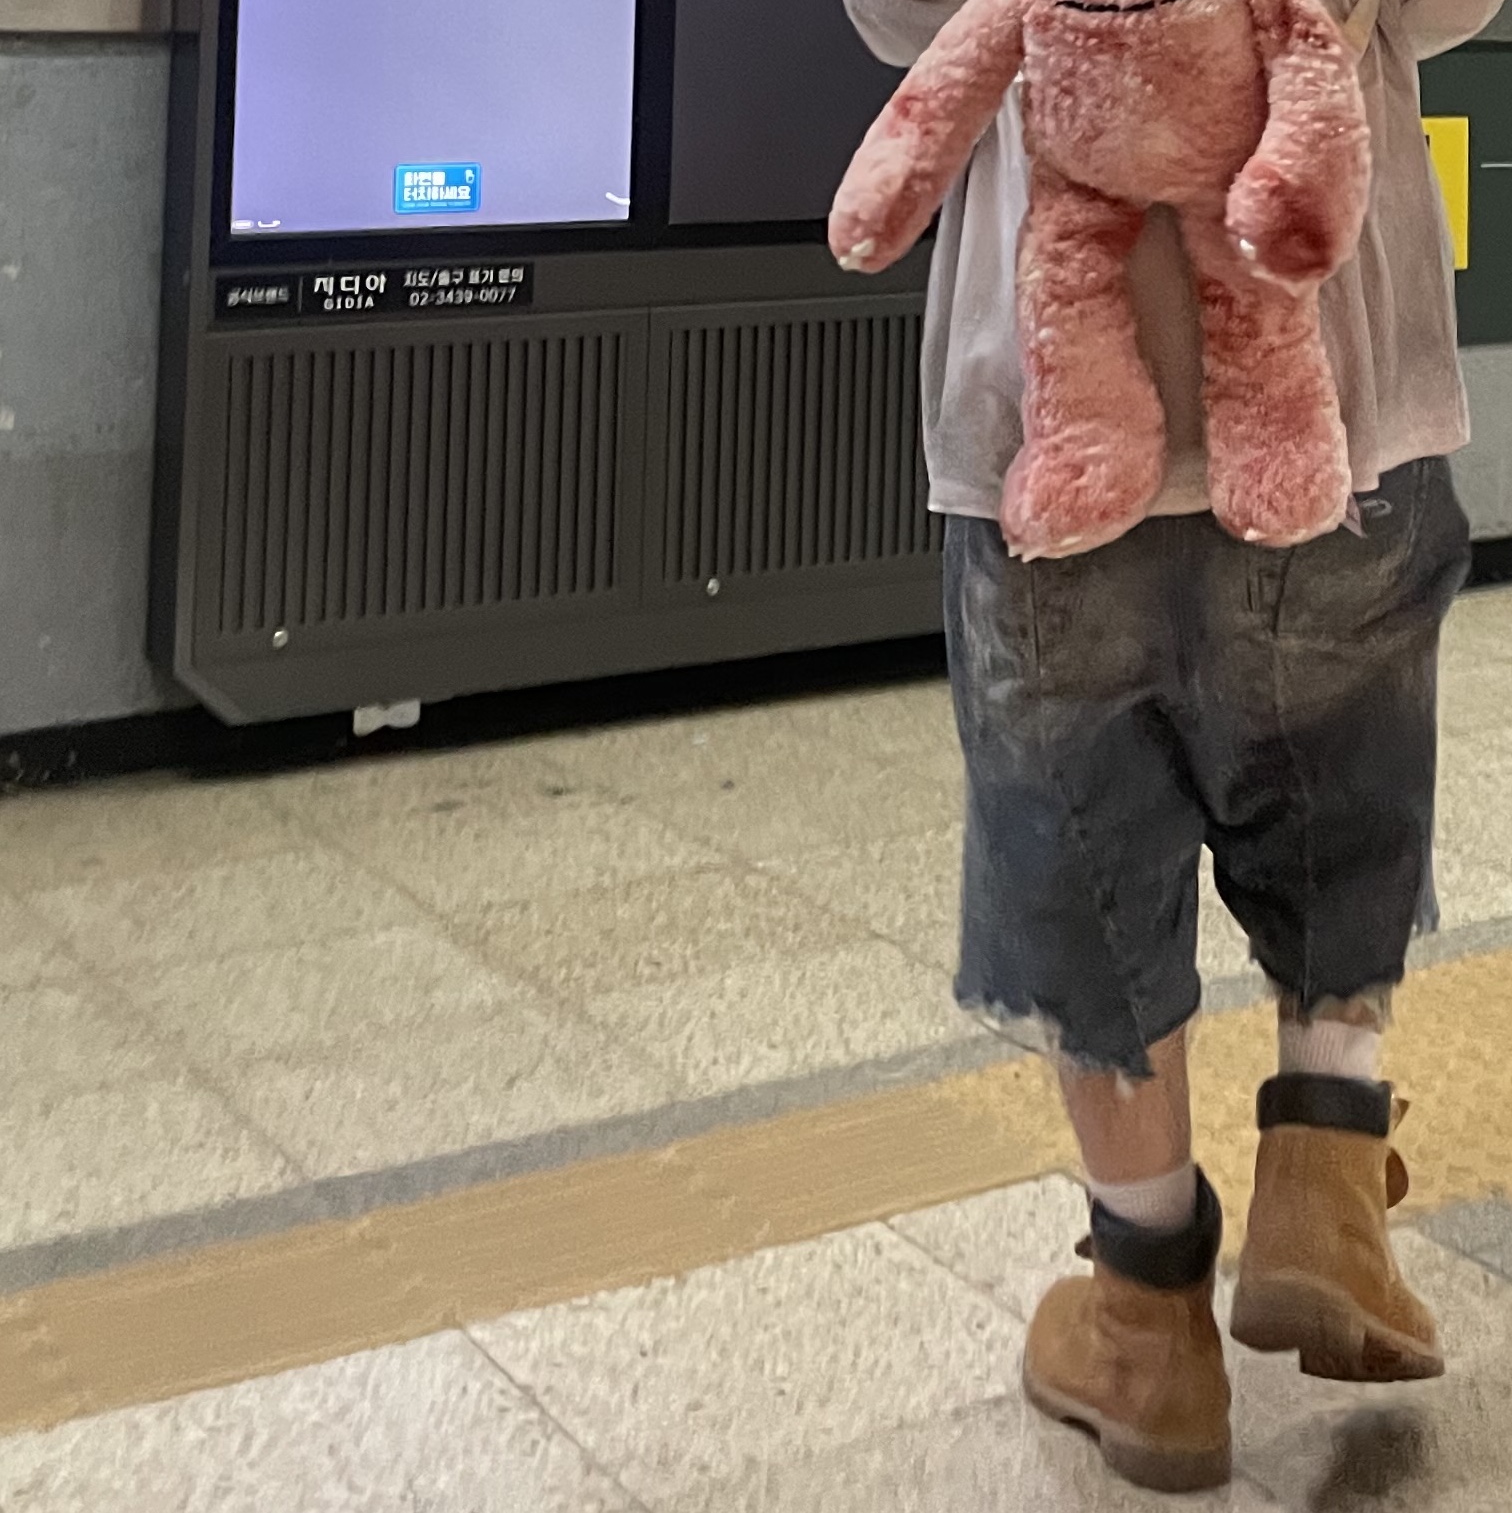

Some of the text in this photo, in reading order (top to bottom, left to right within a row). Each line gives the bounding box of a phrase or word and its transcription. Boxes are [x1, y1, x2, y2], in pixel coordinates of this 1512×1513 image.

[404, 186, 471, 202] 터치하세요
[314, 273, 387, 296] 지디아
[323, 286, 517, 310] GIDIA 02-3439-0077
